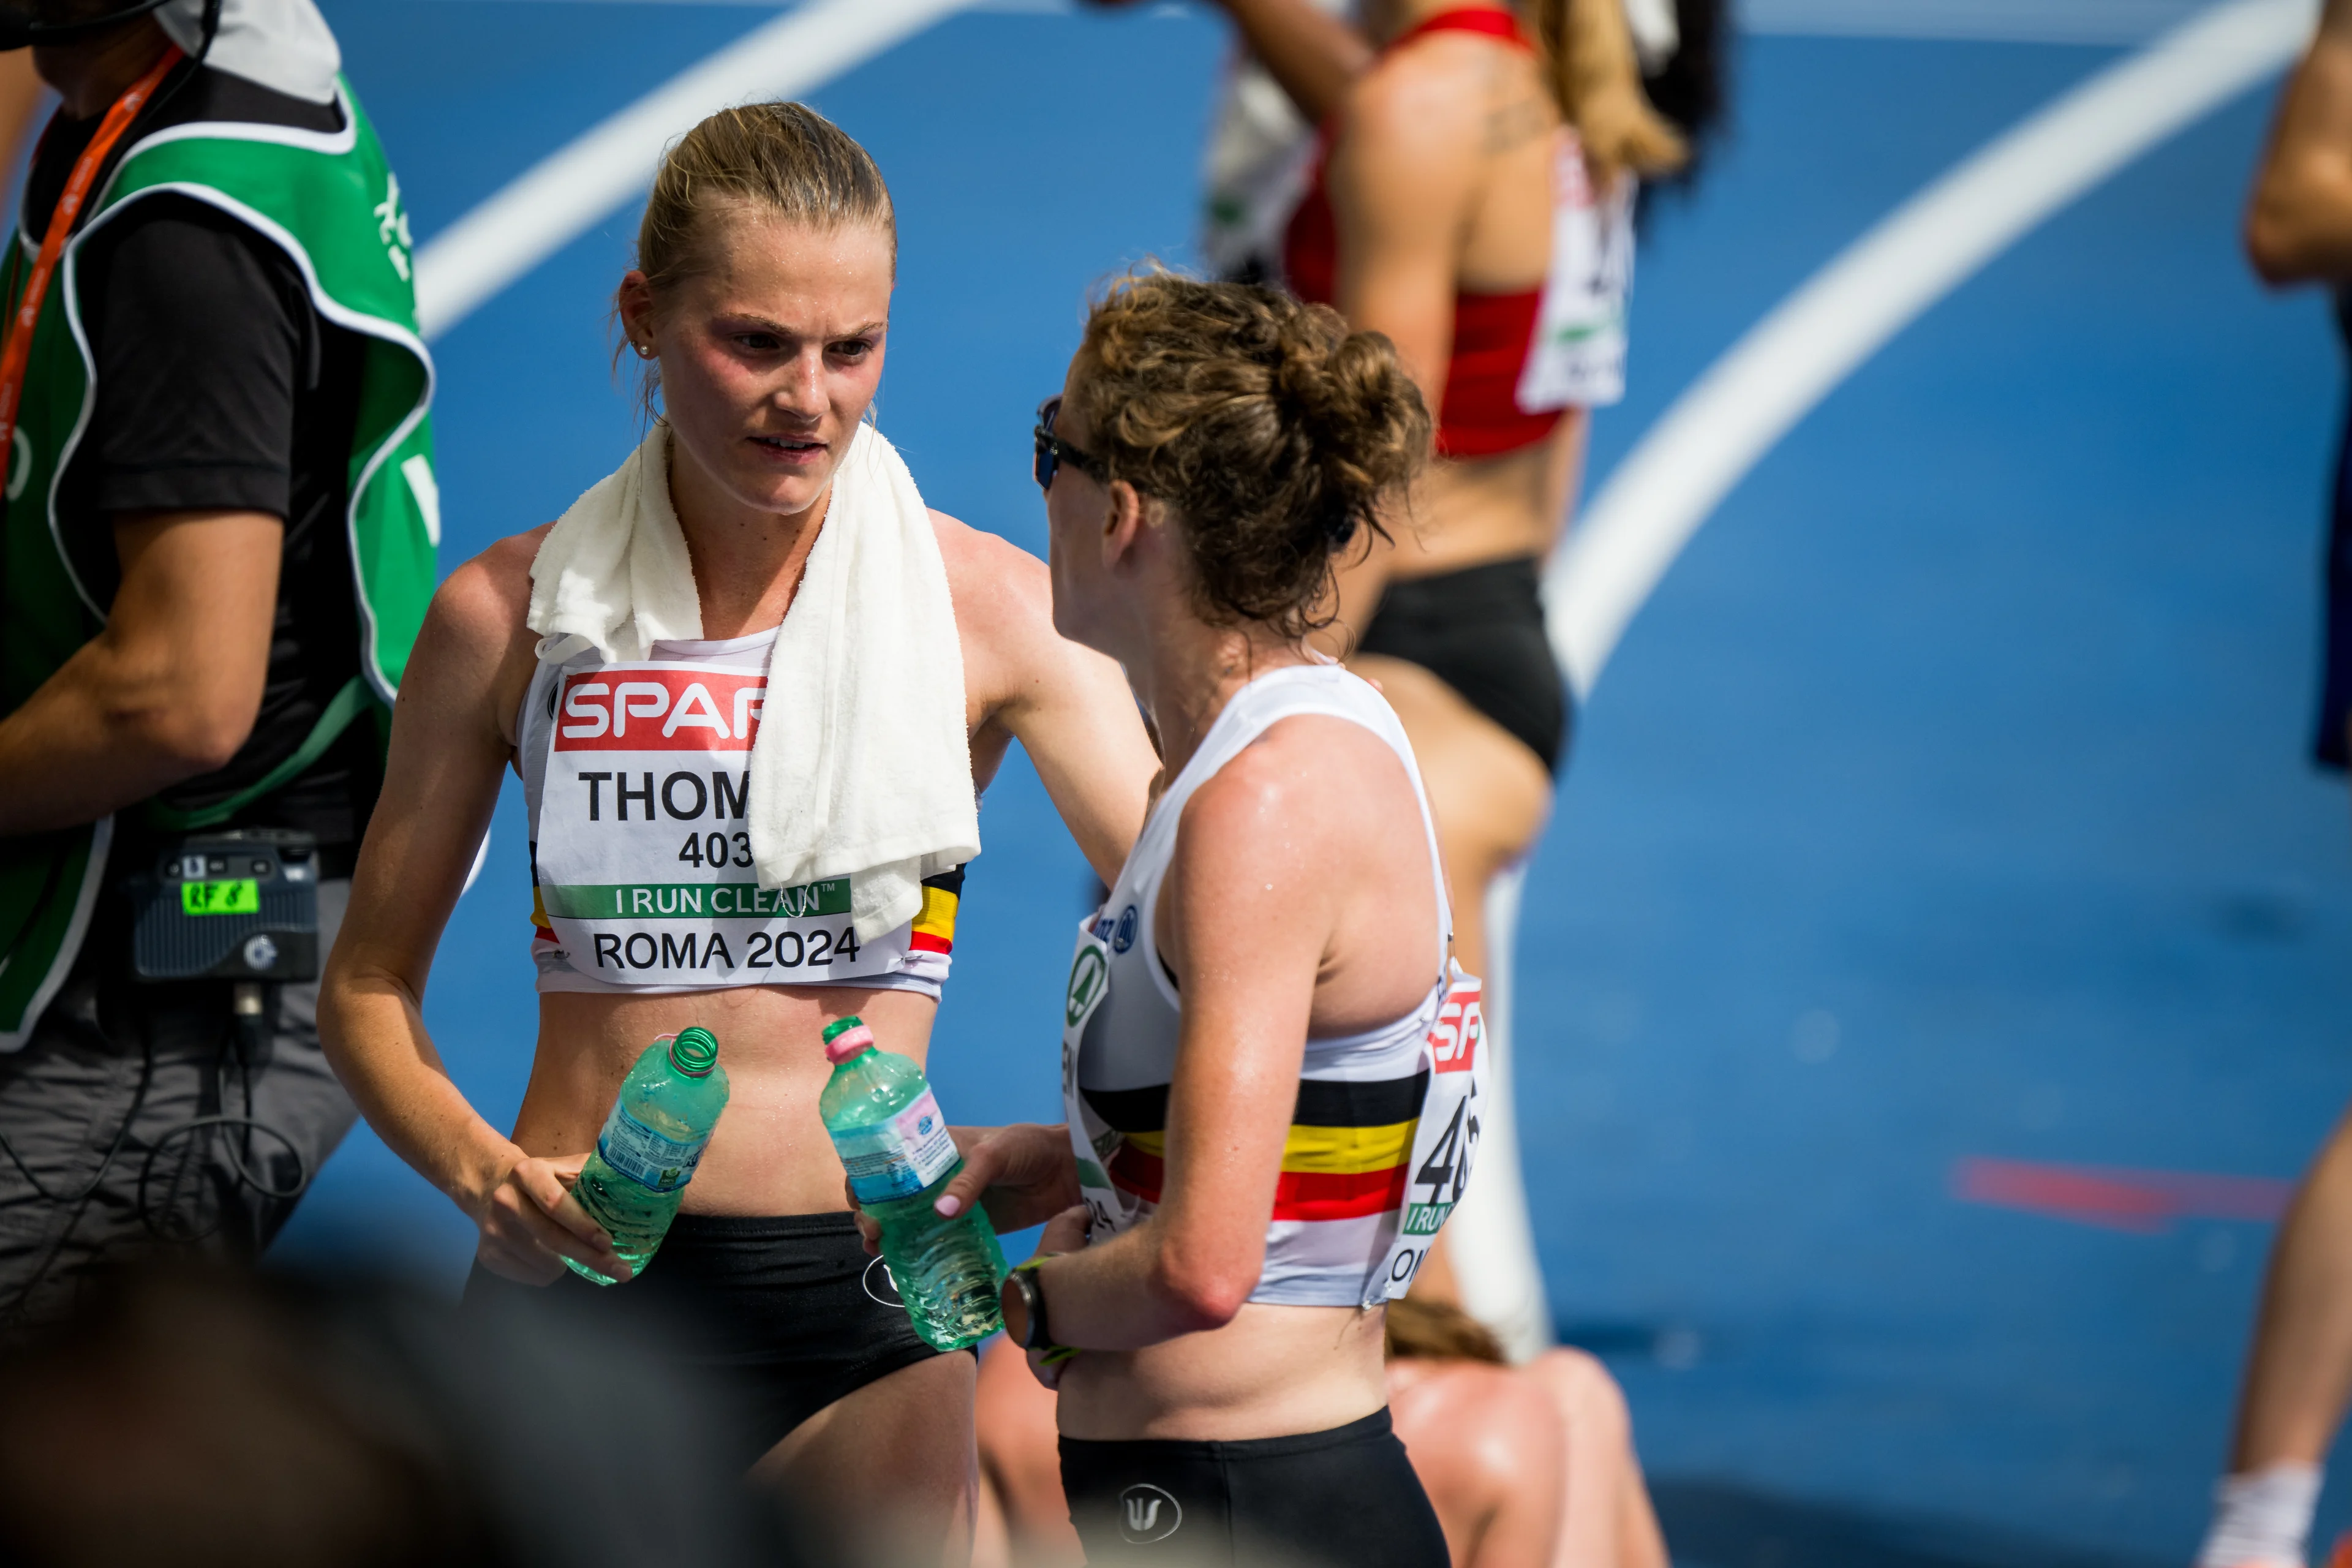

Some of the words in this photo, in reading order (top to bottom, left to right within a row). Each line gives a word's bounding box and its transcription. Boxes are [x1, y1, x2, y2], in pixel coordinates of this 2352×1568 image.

[679, 832, 755, 869] 403
[616, 889, 622, 913] I
[633, 888, 703, 914] RUN
[594, 932, 735, 970] ROMA
[747, 926, 861, 968] 2024
